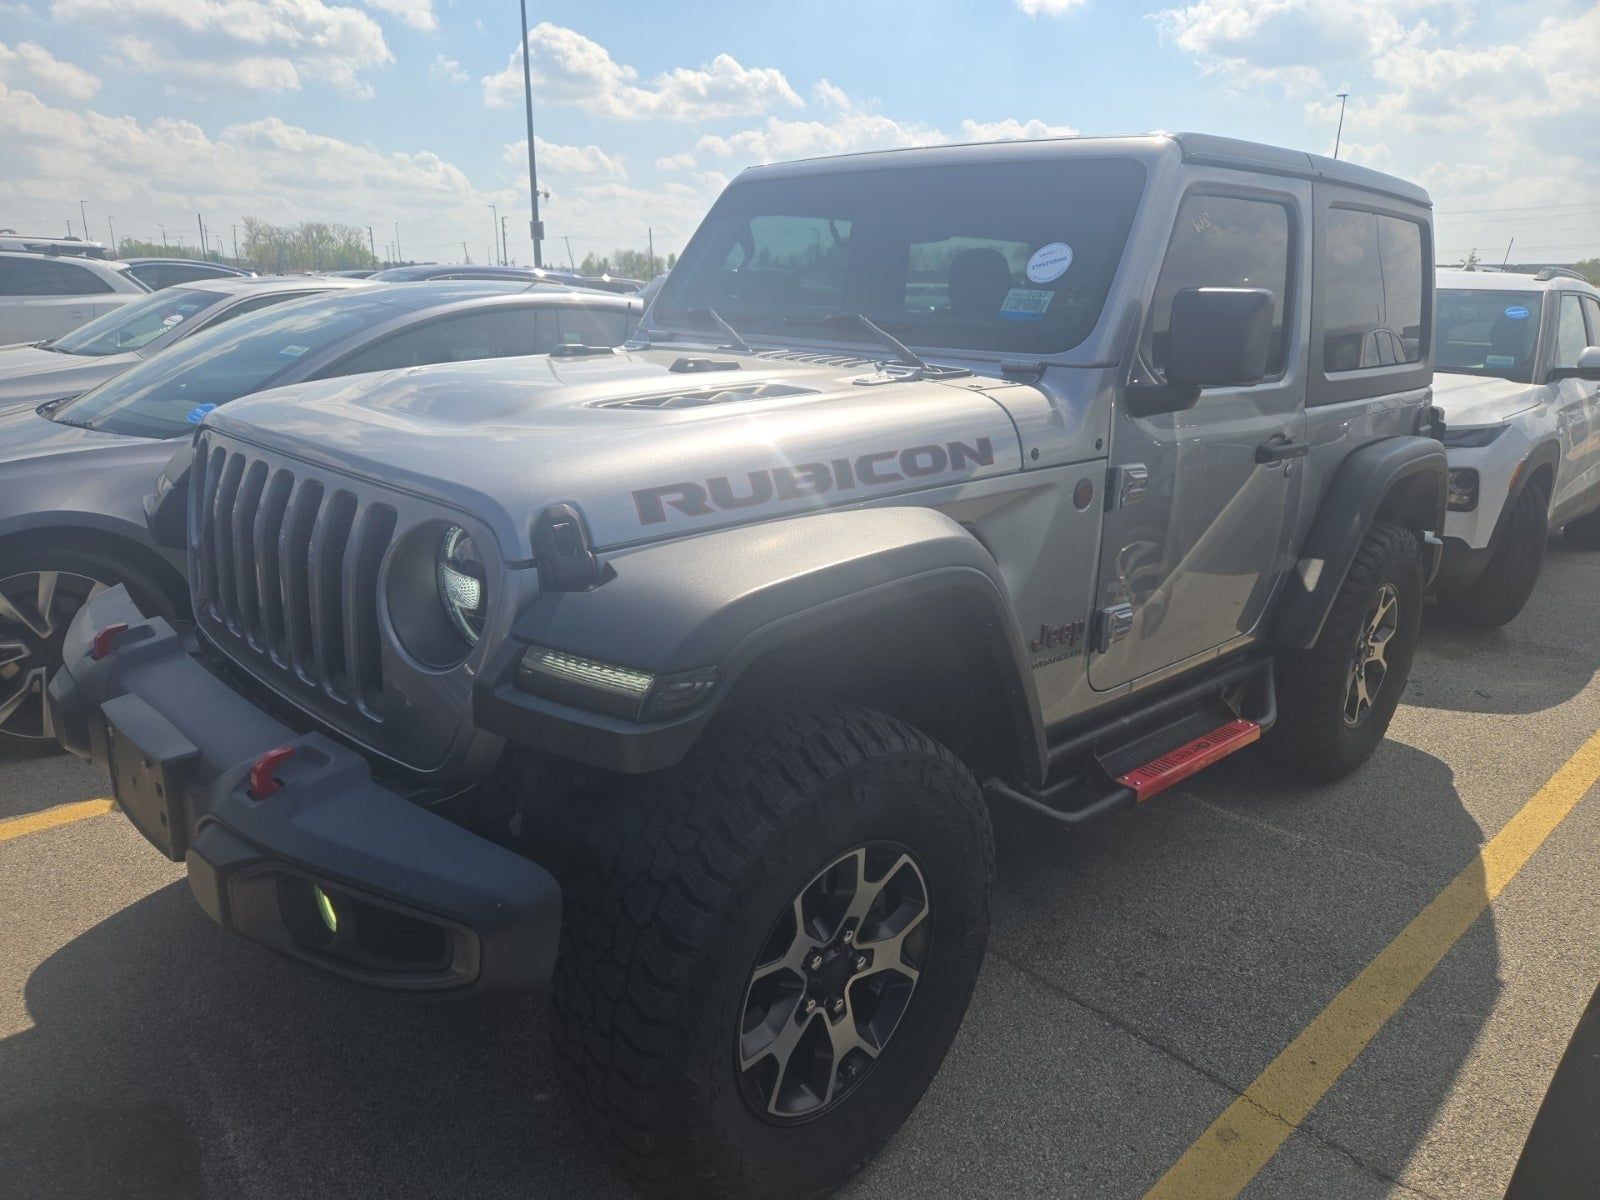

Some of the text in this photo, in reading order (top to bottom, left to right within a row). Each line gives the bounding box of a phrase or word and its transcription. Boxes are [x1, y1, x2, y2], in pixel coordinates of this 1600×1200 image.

[630, 436, 994, 526] RUBICON
[1031, 616, 1086, 653] Jeep
[1031, 648, 1082, 670] WRANGLER
